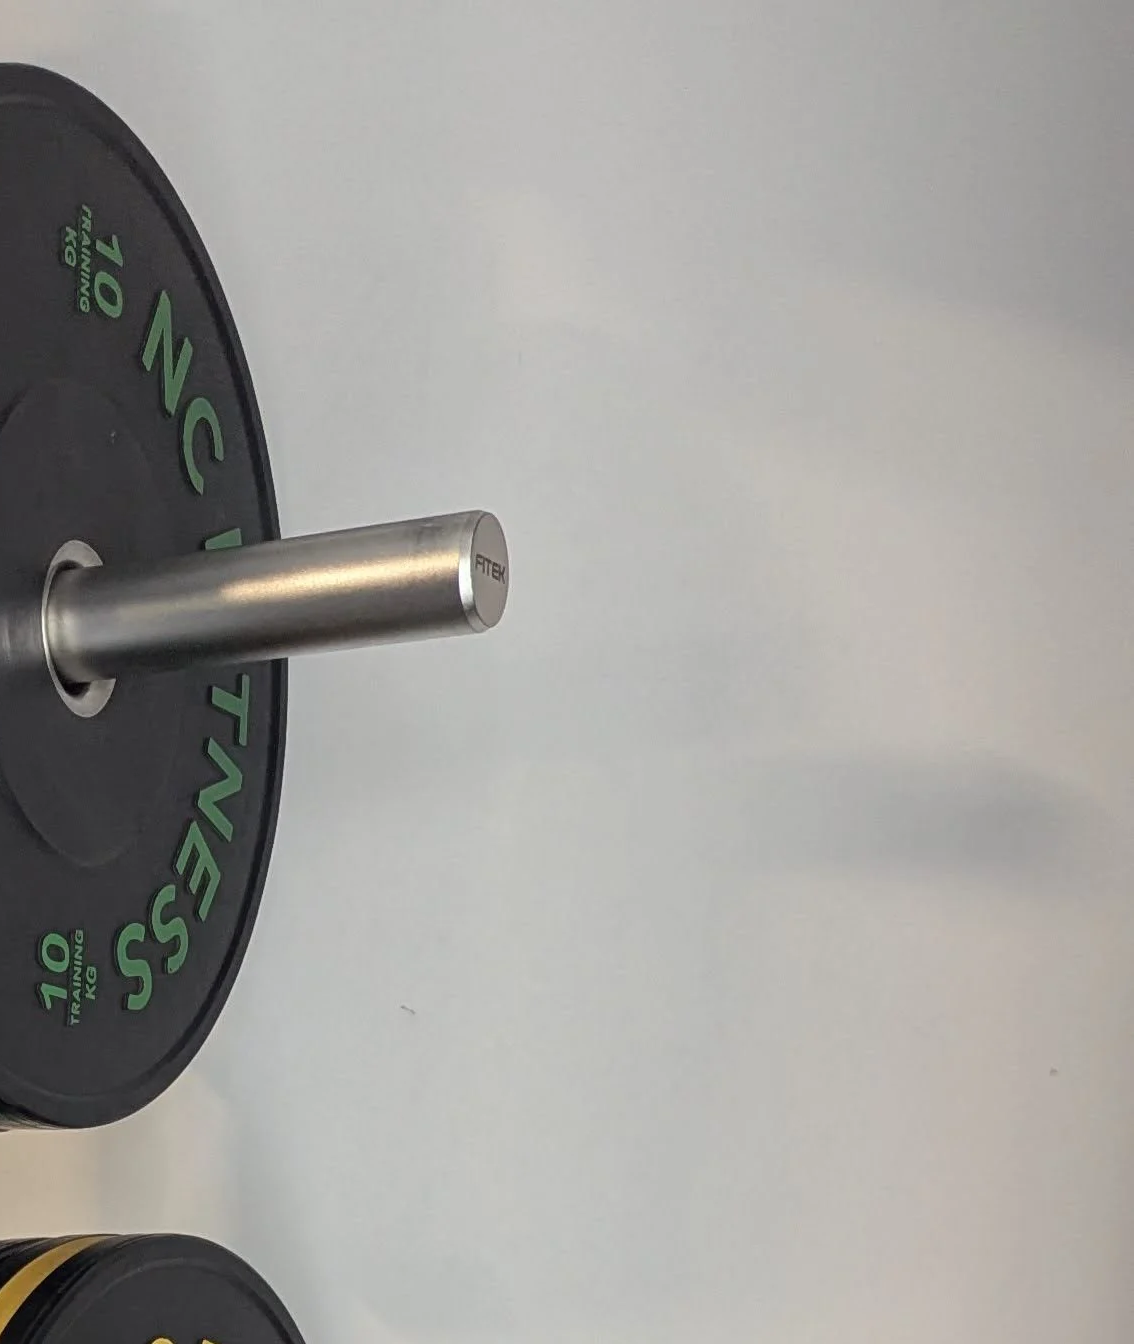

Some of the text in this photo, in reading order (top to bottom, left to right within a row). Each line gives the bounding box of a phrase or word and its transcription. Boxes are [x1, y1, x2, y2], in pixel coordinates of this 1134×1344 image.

[64, 226, 77, 267] KG
[79, 204, 91, 312] TRAINING
[94, 234, 123, 318] 10
[474, 553, 506, 585] FITEK
[117, 290, 250, 1010] NC TNESS
[40, 933, 70, 1010] 10
[70, 929, 84, 1025] TRAINING
[85, 966, 97, 1000] KG
